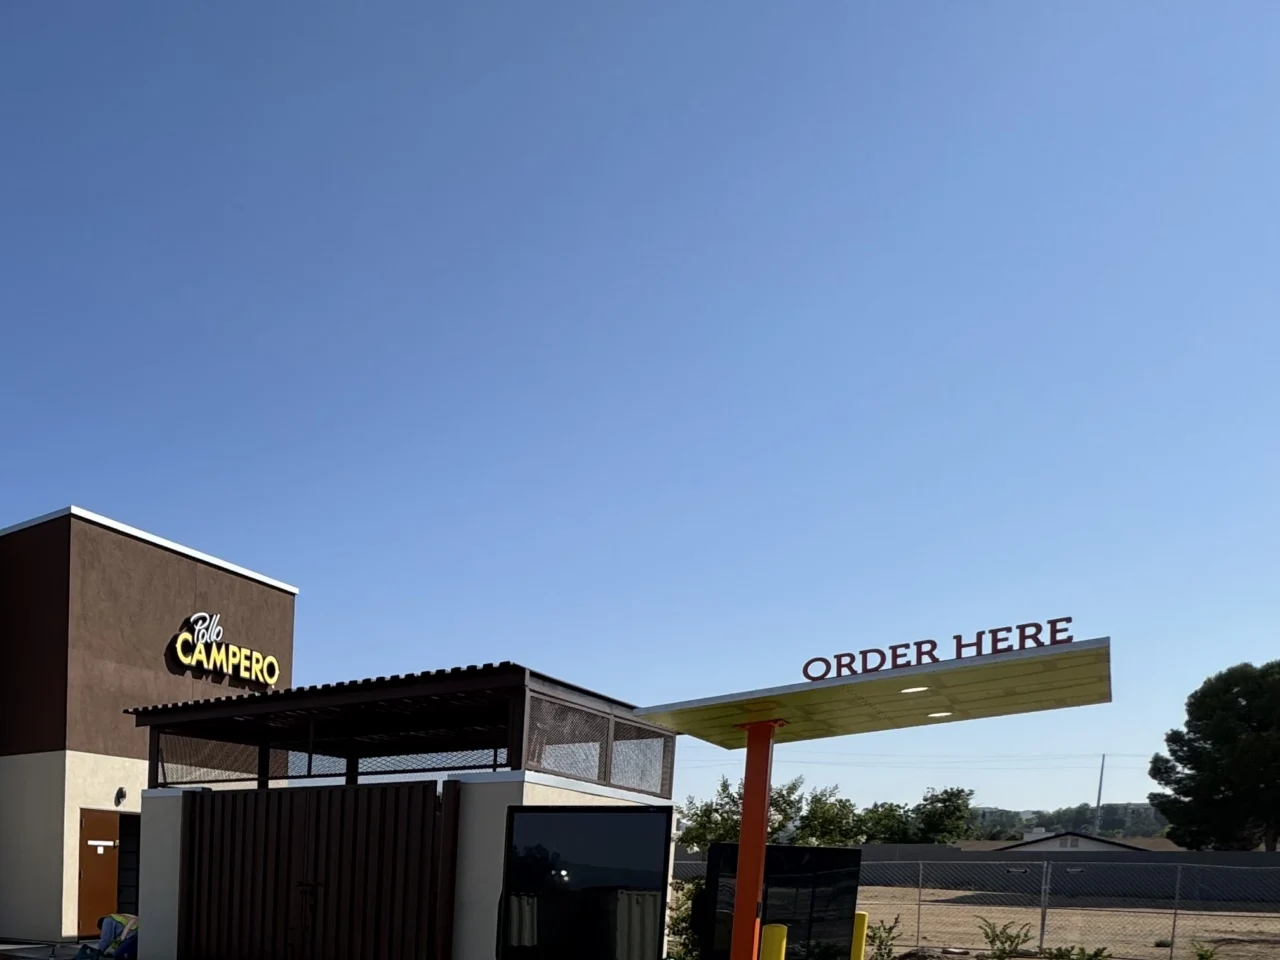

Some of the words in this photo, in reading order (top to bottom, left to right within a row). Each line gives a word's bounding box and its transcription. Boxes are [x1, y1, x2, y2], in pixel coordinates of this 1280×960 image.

[190, 611, 224, 644] Pollo
[802, 639, 940, 682] ORDER
[953, 616, 1074, 660] HERE
[175, 631, 280, 685] CAMPERO
